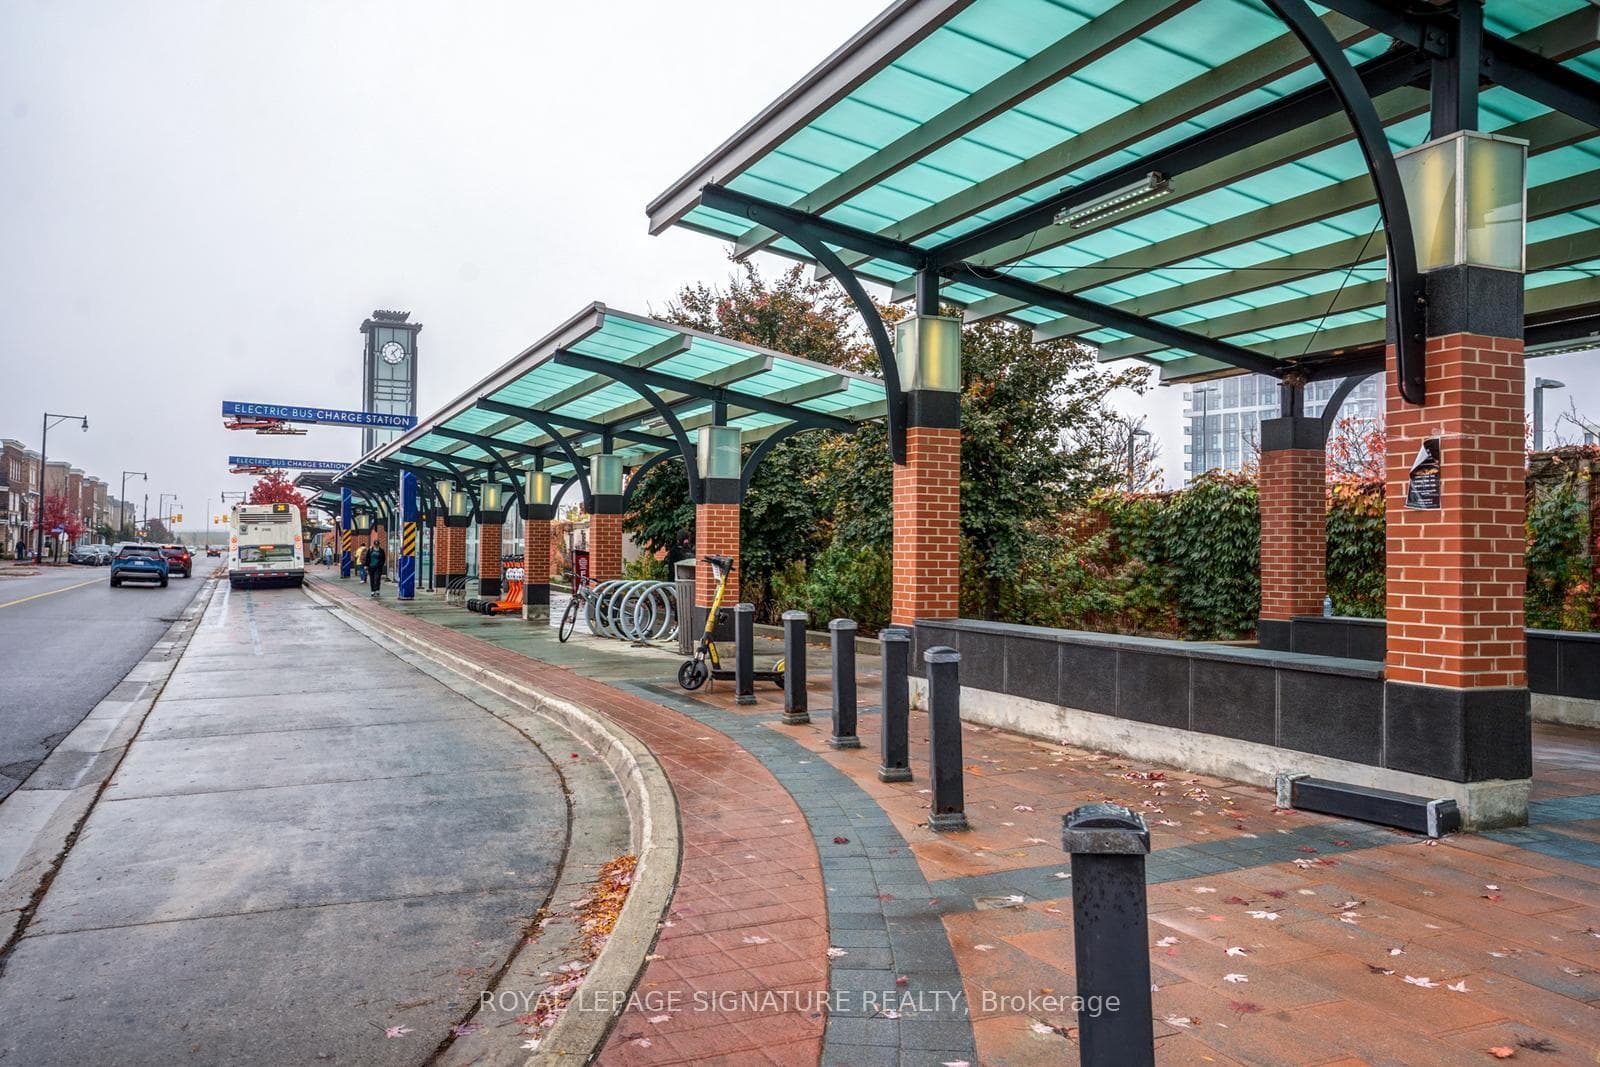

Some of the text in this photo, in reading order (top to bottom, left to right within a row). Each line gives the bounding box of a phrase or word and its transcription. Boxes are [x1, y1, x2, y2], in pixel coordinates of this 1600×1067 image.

[234, 404, 410, 426] ELECTRIC BUS CHARGE STATION
[236, 457, 270, 466] ELECTRIC
[287, 460, 316, 468] CHARGE
[318, 462, 347, 470] STATION
